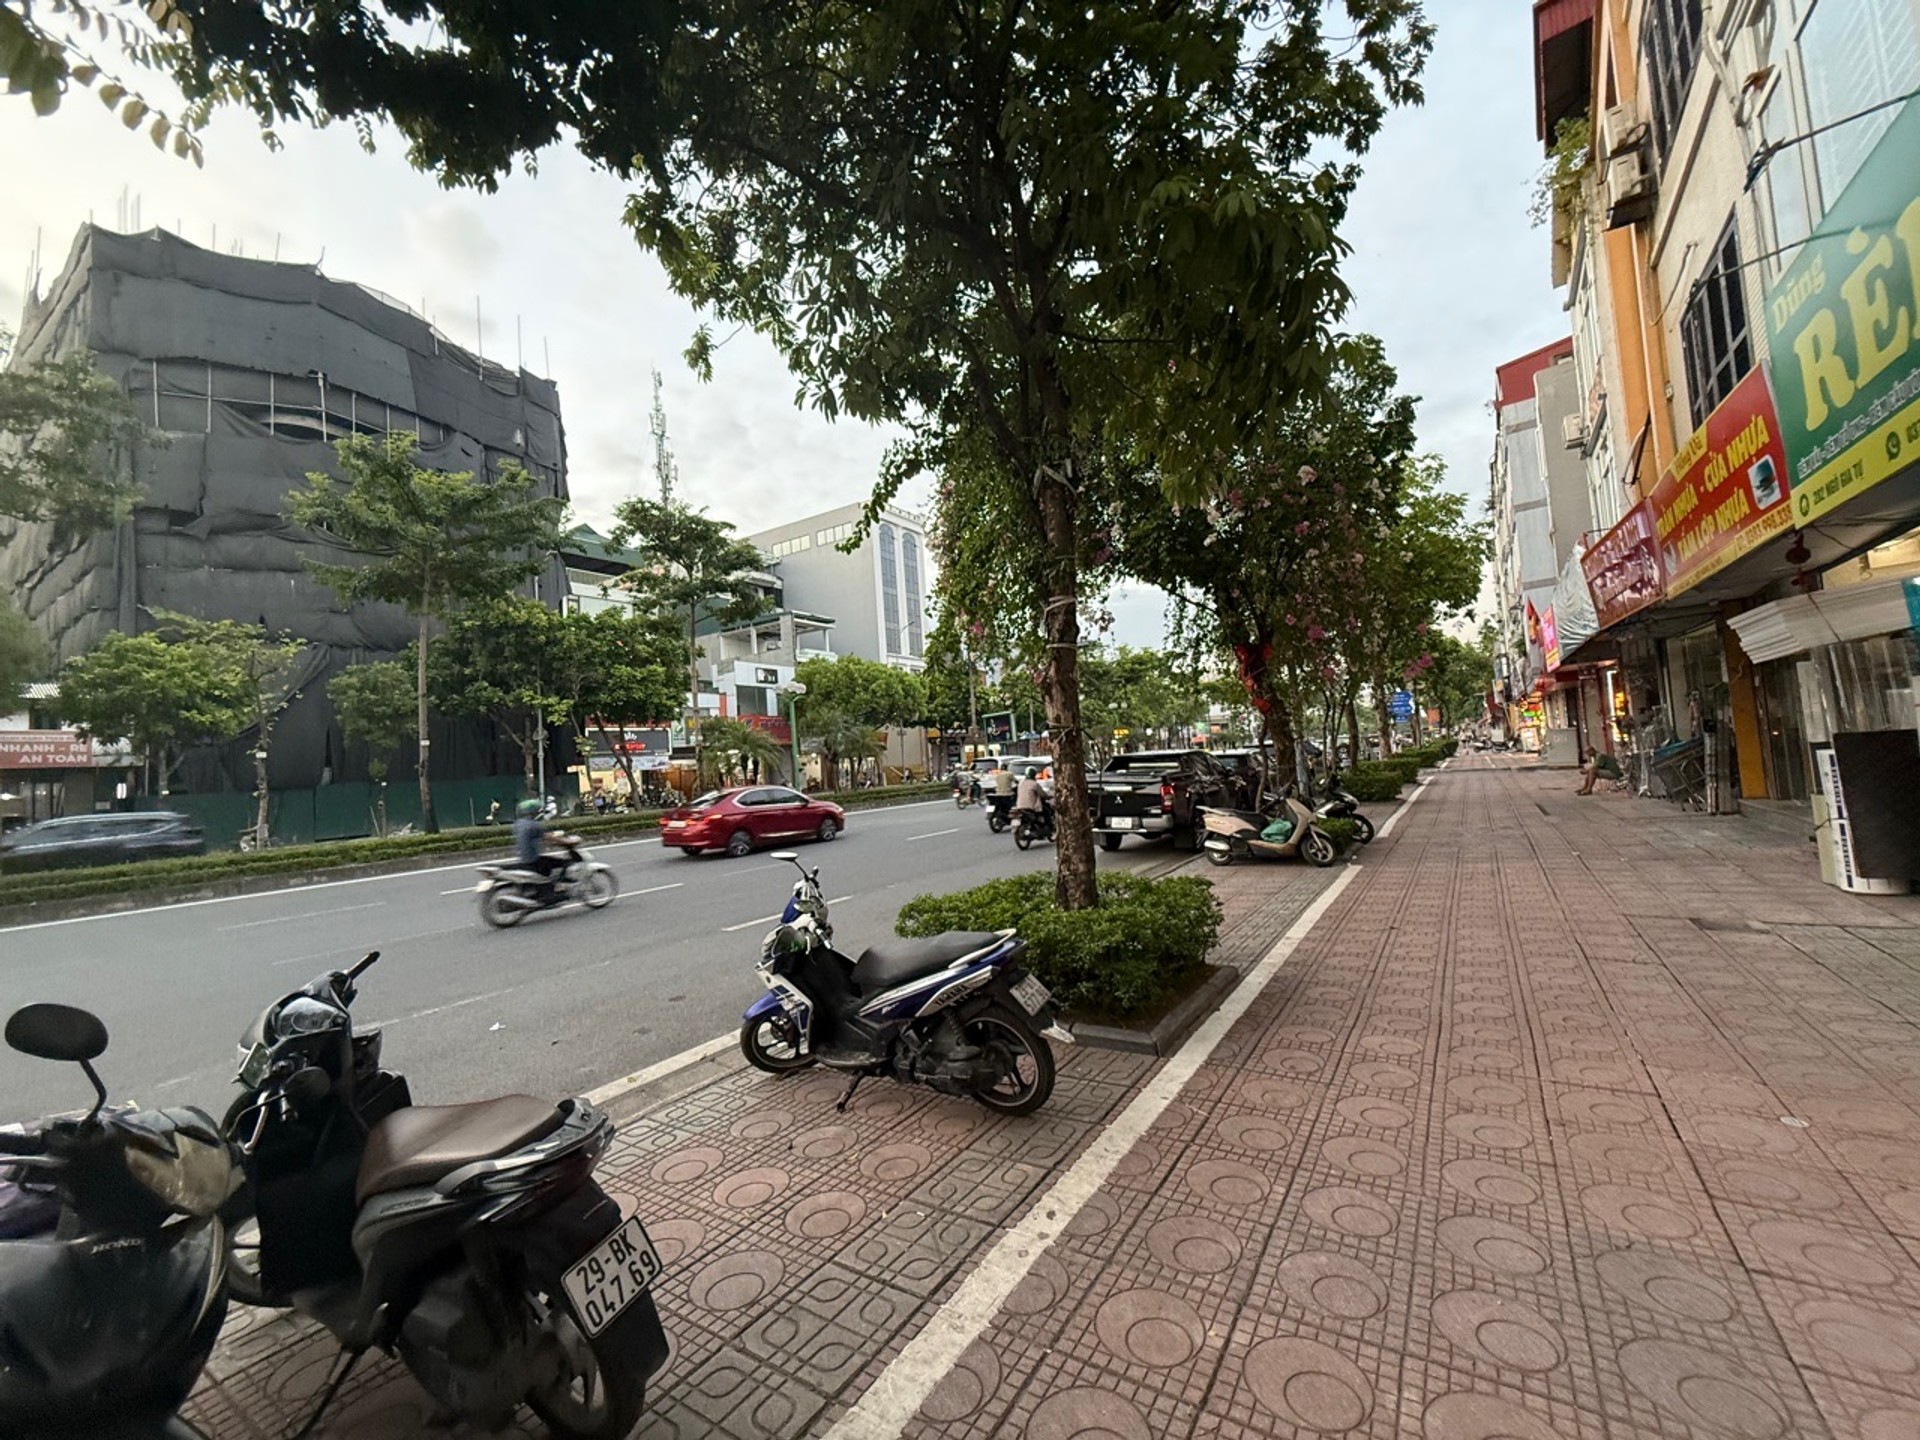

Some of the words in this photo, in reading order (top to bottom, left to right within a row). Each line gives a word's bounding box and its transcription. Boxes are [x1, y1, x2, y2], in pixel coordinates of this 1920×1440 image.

[1704, 451, 1728, 492] CỬA
[1726, 414, 1770, 473] NHỰA
[1715, 486, 1750, 534] NHỰA
[0, 743, 55, 752] NHANH
[20, 754, 42, 763] AN
[576, 1227, 637, 1296] 29-BK
[585, 1250, 656, 1328] 047.69
